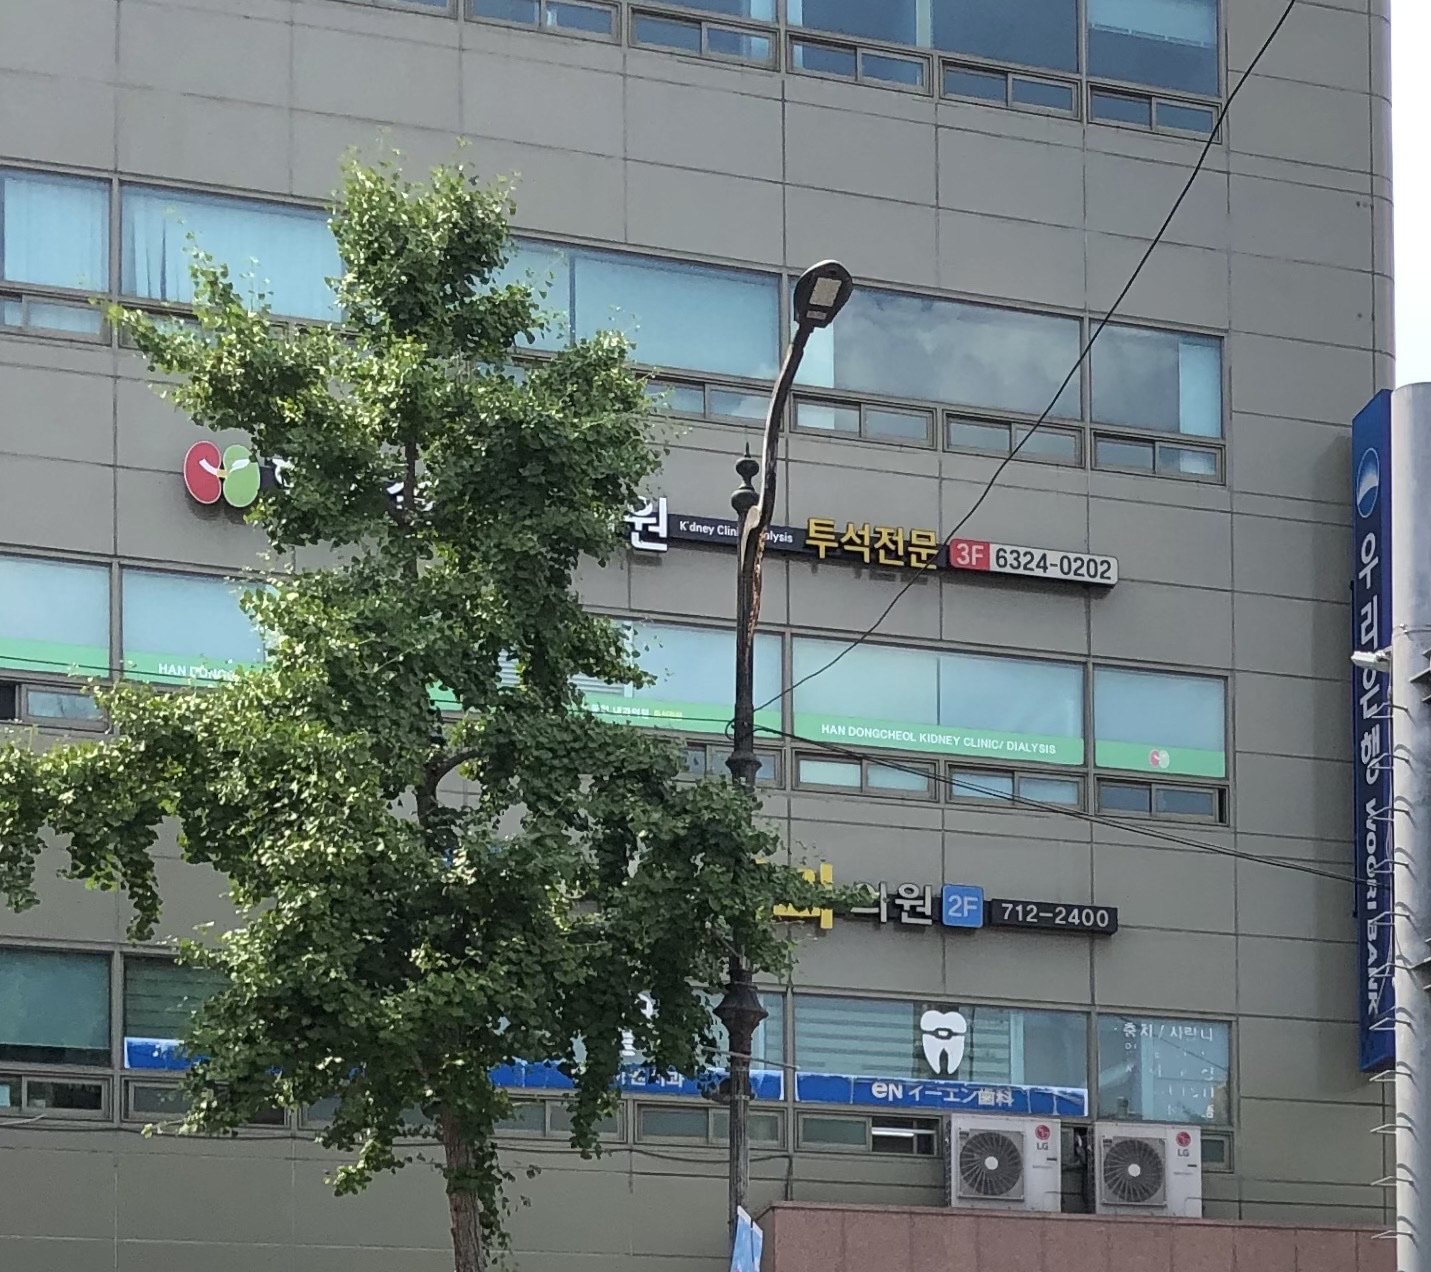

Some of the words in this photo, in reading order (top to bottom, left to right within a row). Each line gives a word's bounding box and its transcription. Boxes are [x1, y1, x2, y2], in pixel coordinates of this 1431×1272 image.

[679, 520, 715, 536] Kdney
[716, 525, 740, 537] Clini
[805, 516, 939, 570] 투석전문
[956, 542, 984, 566] 3F
[995, 547, 1112, 580] 6324-0202
[158, 663, 187, 677] HAN
[1358, 532, 1381, 785] 우리은행
[821, 723, 846, 736] HAN
[848, 726, 917, 742] DONGCHEOL
[919, 733, 961, 746] KIDNEY
[963, 737, 1004, 750] CLINIC/
[1006, 740, 1057, 755] DIALYSIS
[947, 894, 979, 918] 2F
[1001, 902, 1110, 928] 712-2400
[1366, 918, 1380, 1017] BANK
[908, 1084, 1015, 1107] イーエン歯科
[1036, 1141, 1049, 1151] LG
[1176, 1148, 1190, 1157] LG
